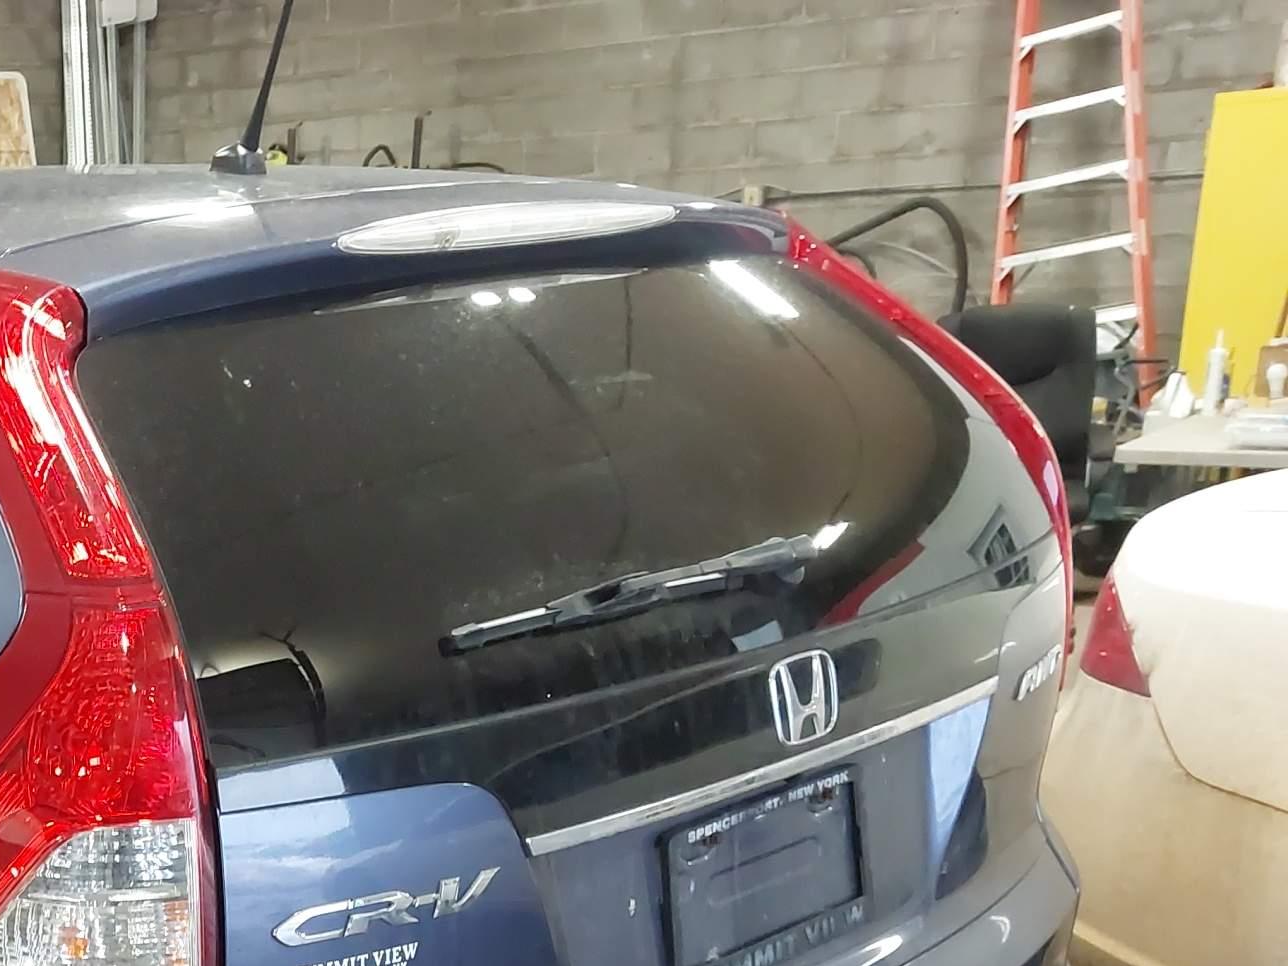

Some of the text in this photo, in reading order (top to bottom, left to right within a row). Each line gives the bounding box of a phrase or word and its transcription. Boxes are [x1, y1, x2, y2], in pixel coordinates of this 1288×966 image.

[788, 782, 815, 802] NEW
[816, 770, 849, 792] YORK
[271, 866, 501, 948] CR-V
